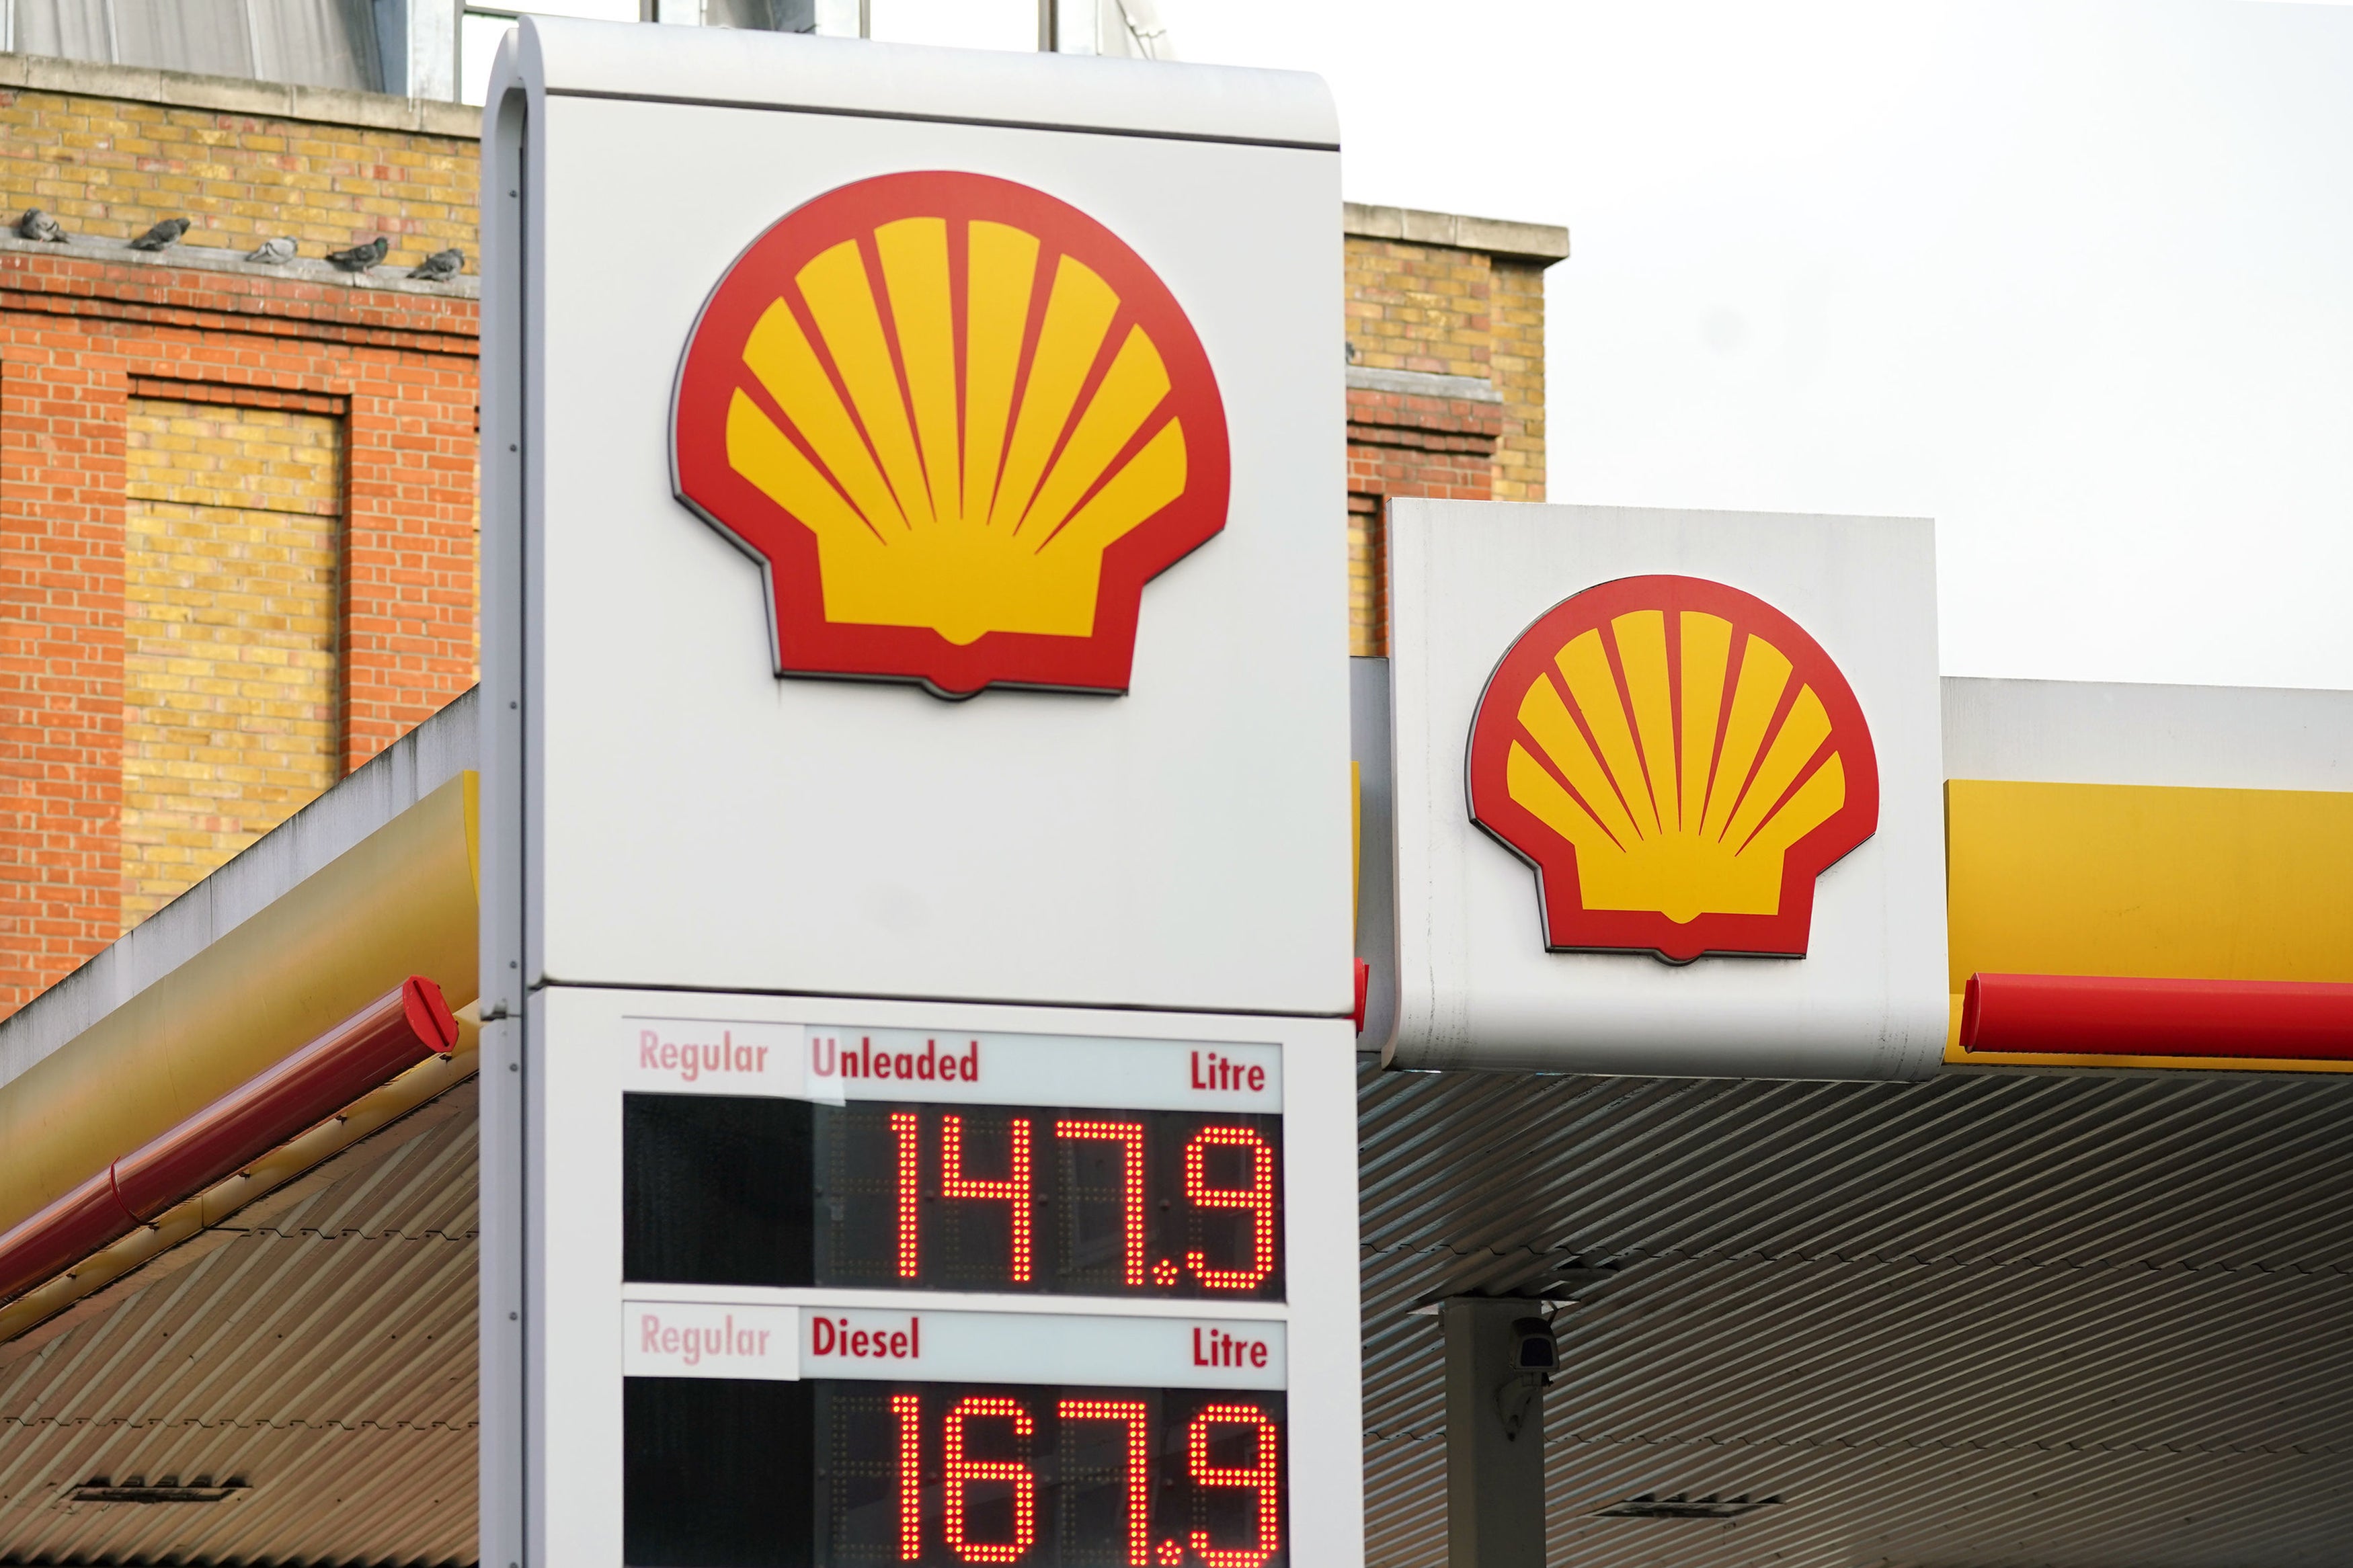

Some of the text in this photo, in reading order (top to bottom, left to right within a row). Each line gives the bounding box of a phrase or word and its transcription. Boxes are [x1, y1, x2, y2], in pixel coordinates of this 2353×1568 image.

[639, 1030, 1265, 1091] Regular Unleaded Litre
[890, 1112, 1274, 1289] 147.9
[641, 1315, 1269, 1368] Regular Diesel Litre
[891, 1395, 1277, 1568] 167.9
